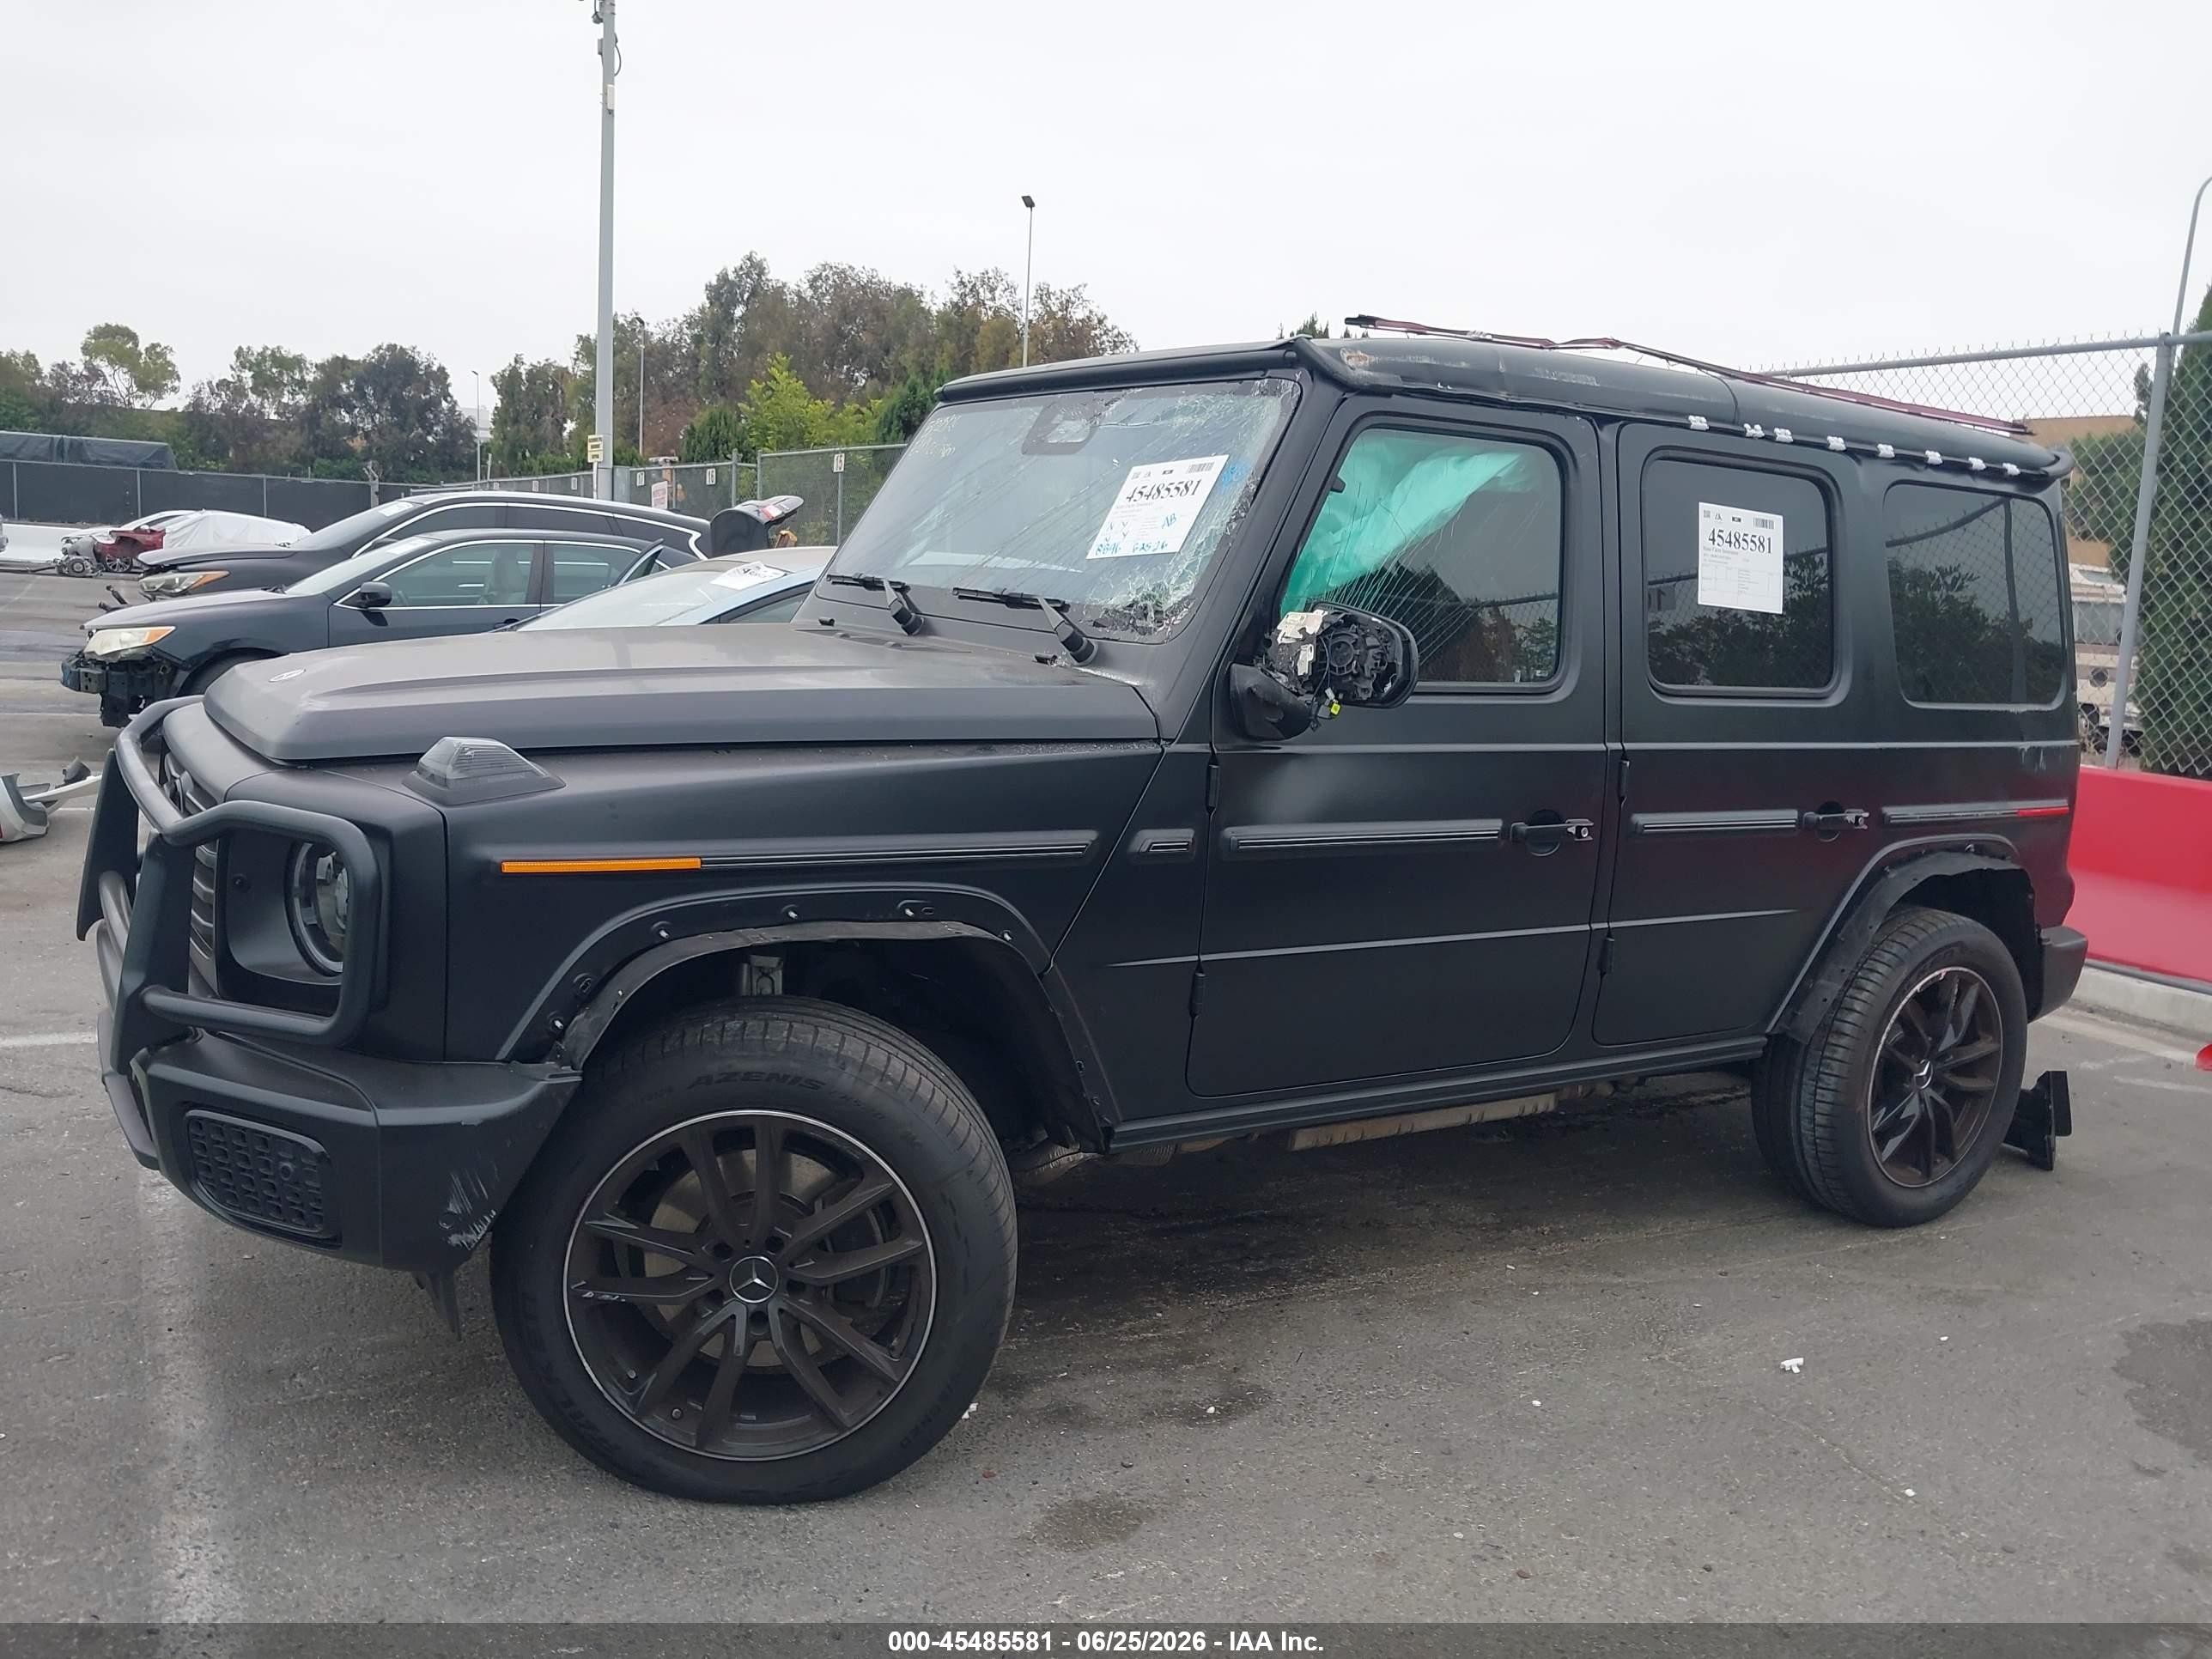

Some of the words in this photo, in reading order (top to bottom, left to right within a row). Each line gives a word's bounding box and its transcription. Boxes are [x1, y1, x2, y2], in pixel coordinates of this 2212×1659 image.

[1126, 478, 1202, 503] 45485581
[1707, 527, 1772, 555] 45485581
[687, 1070, 827, 1091] AZENIS
